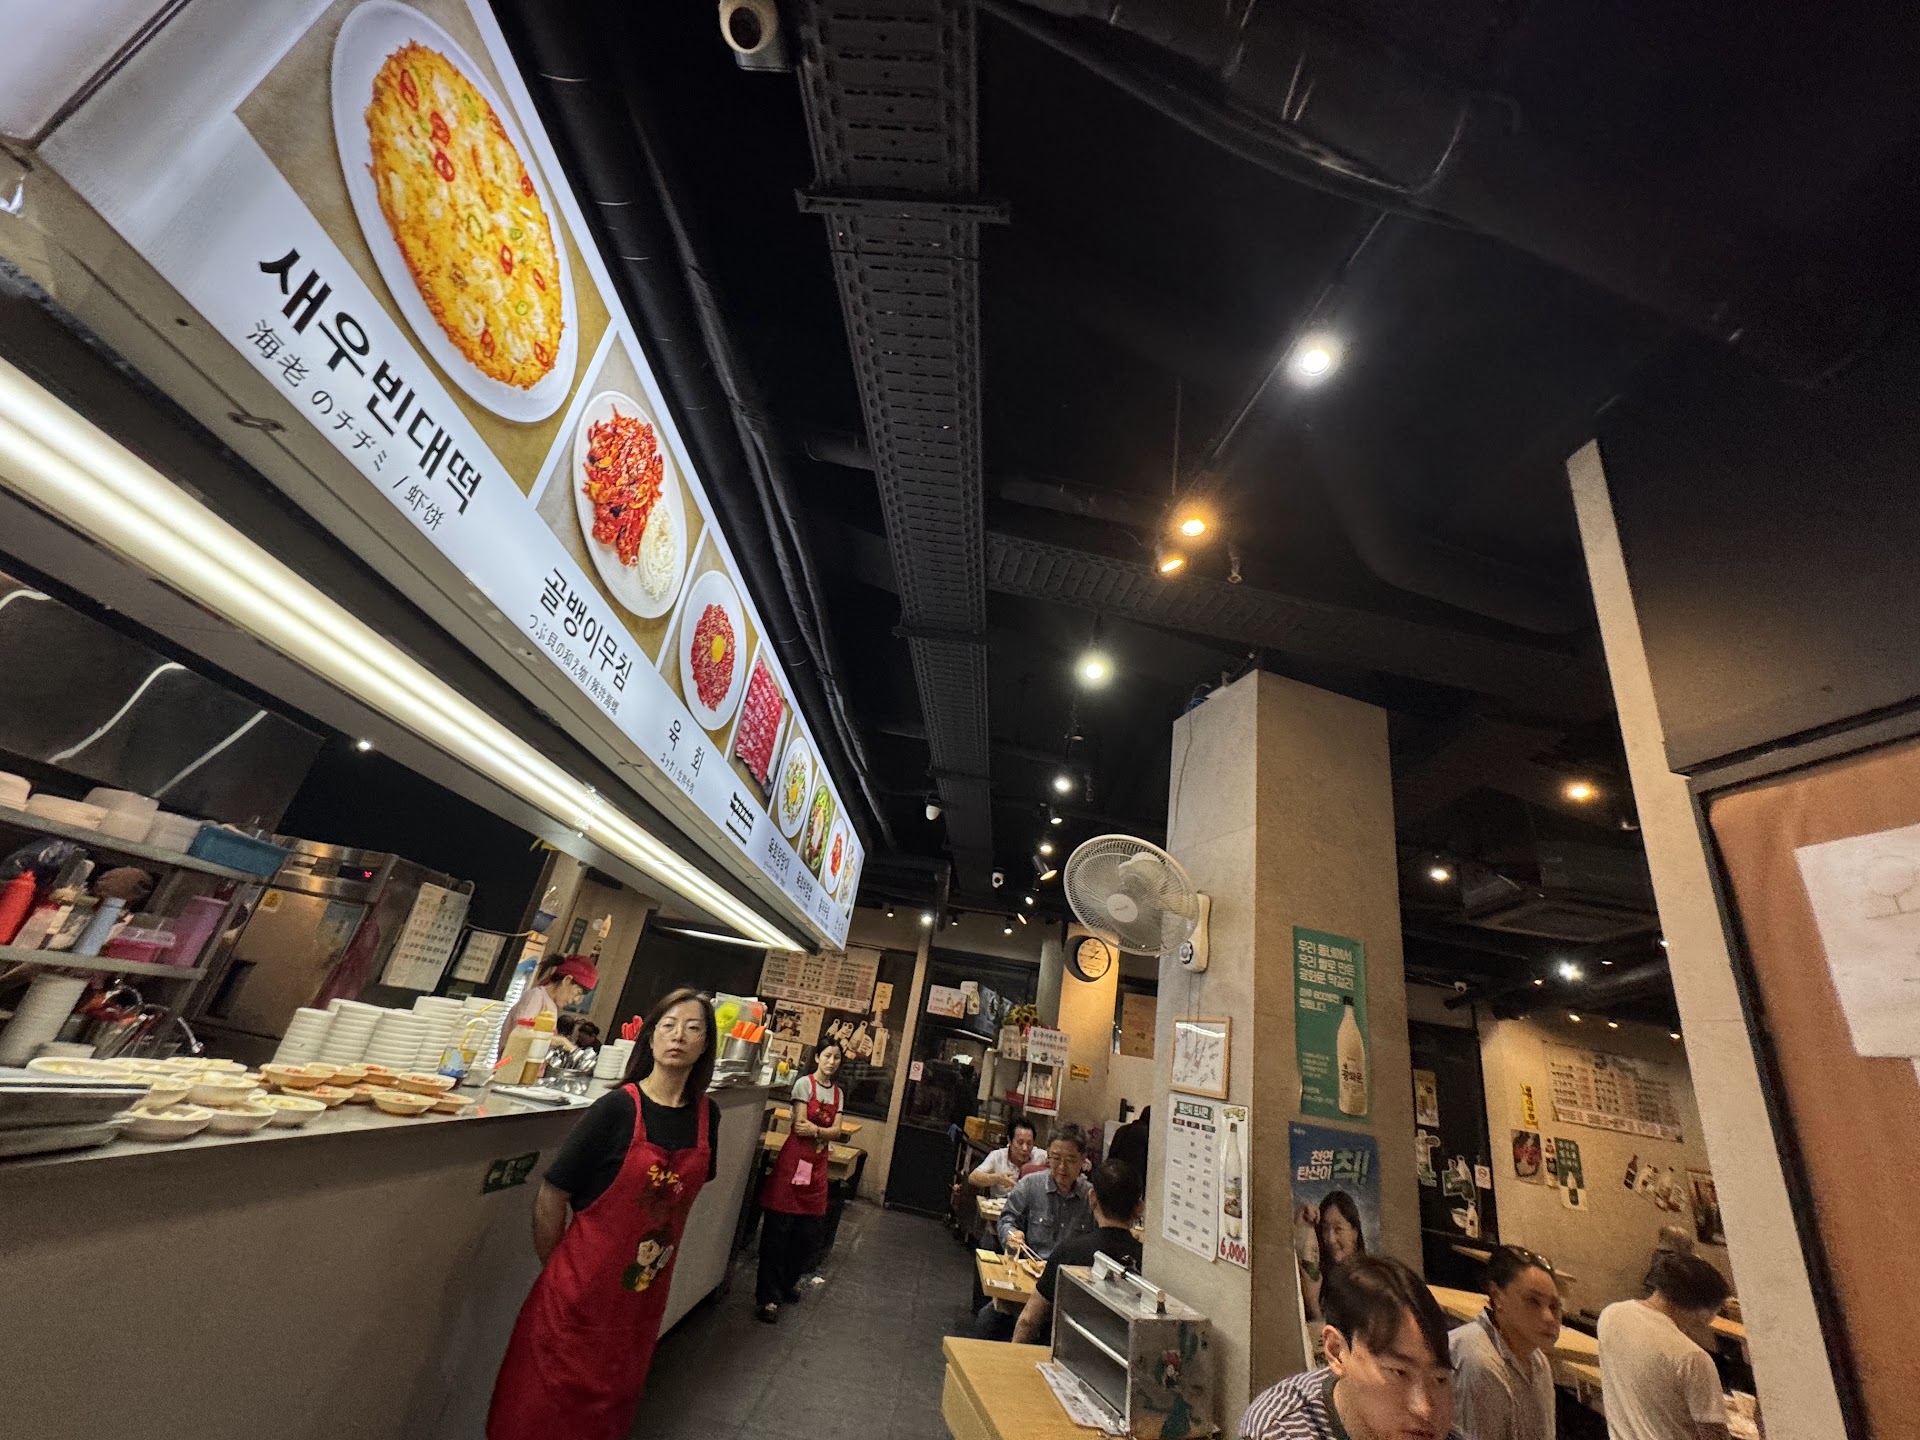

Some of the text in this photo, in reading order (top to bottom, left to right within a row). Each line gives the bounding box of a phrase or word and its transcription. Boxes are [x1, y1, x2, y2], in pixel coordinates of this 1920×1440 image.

[259, 248, 482, 516] 새우빈대떡
[540, 567, 632, 692] 골뱅이무침
[1298, 939, 1316, 954] 우리
[1298, 954, 1317, 969] 우리
[1311, 1150, 1334, 1165] 천연
[1297, 1164, 1333, 1181] 탄산이
[1220, 1237, 1246, 1265] 6,000
